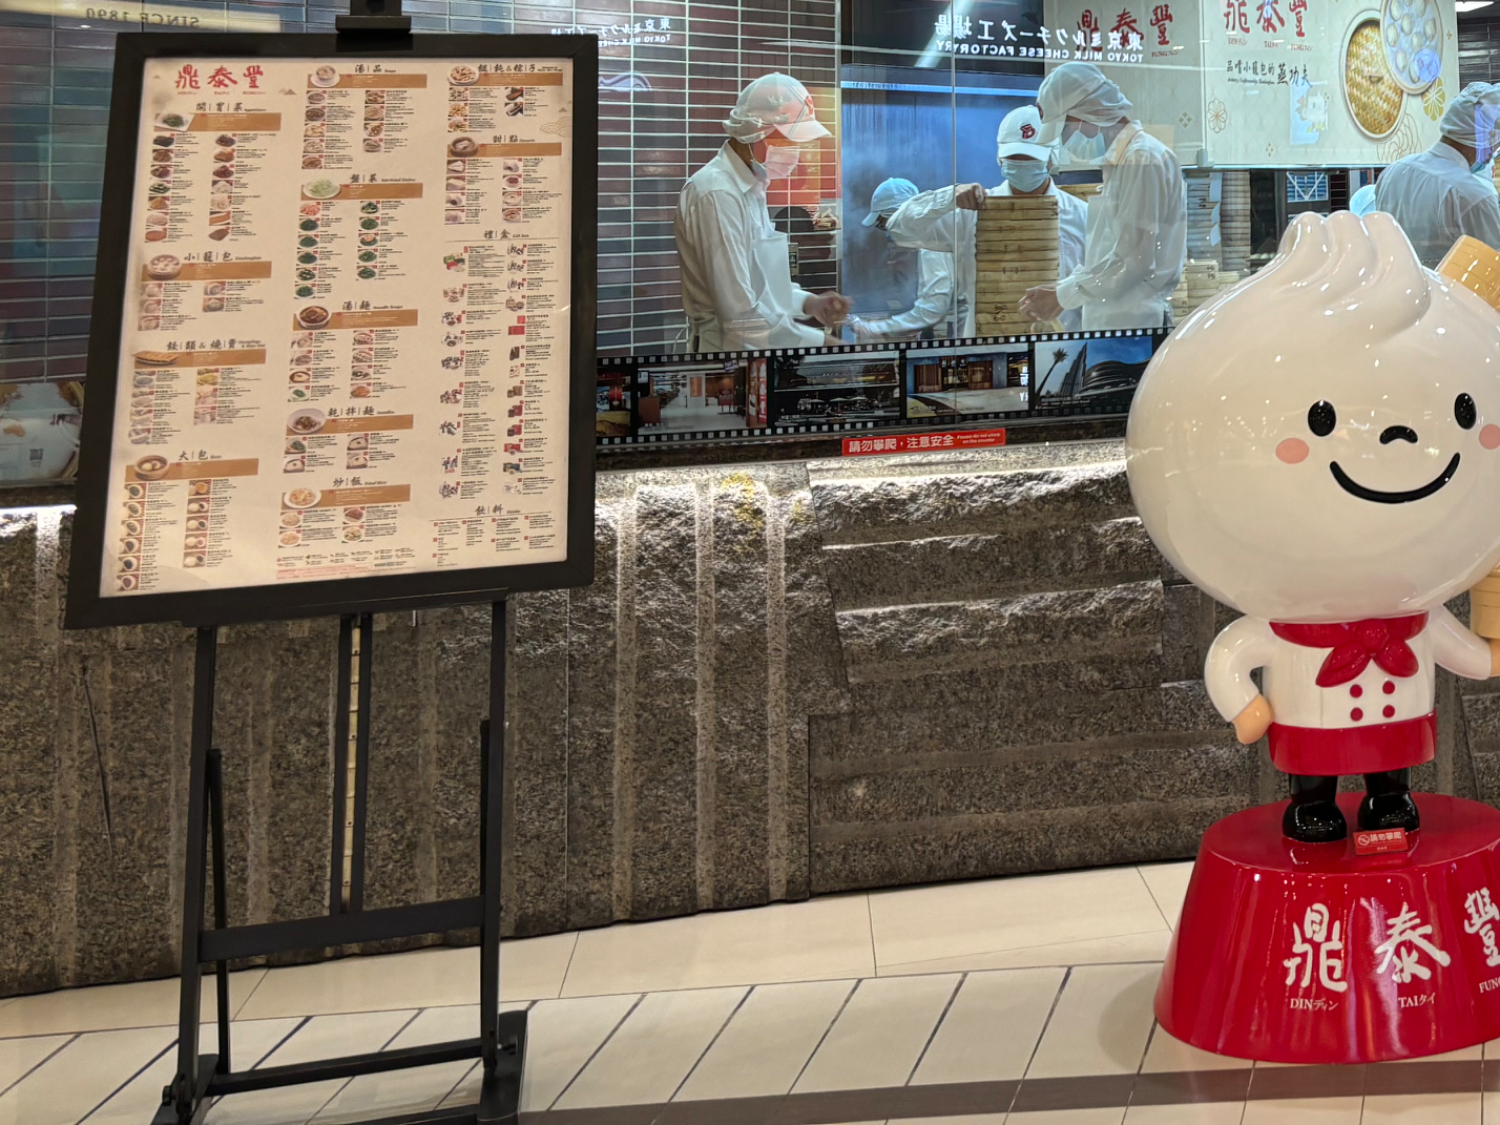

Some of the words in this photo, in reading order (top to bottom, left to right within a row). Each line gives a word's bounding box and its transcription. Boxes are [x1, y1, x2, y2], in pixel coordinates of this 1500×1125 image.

[1076, 4, 1174, 52] 鼎泰豐
[174, 64, 264, 89] 鼎泰豐
